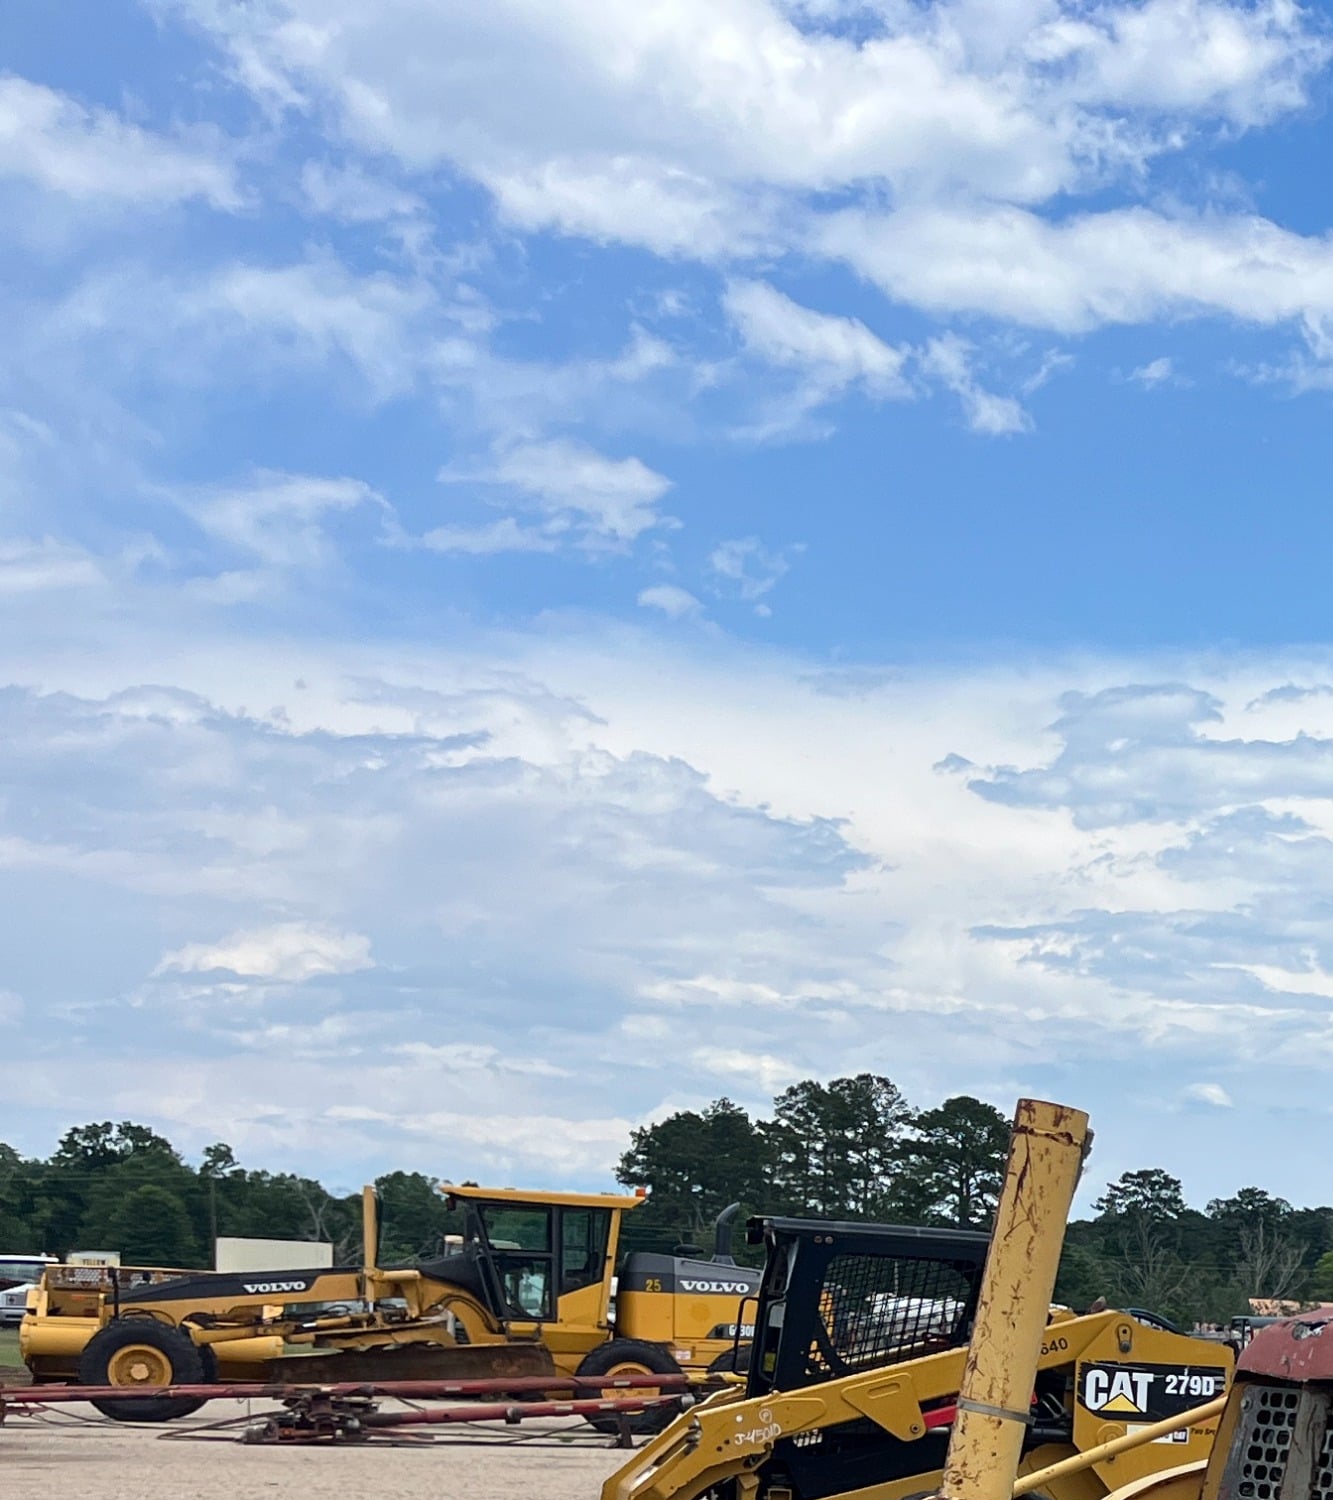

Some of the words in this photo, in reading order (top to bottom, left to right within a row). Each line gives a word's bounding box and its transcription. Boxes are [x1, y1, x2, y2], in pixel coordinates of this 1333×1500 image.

[243, 1281, 306, 1293] VOLVO
[645, 1279, 661, 1292] 25
[680, 1280, 750, 1293] VOLVO
[1084, 1369, 1154, 1413] CAT
[1164, 1374, 1215, 1397] 279D
